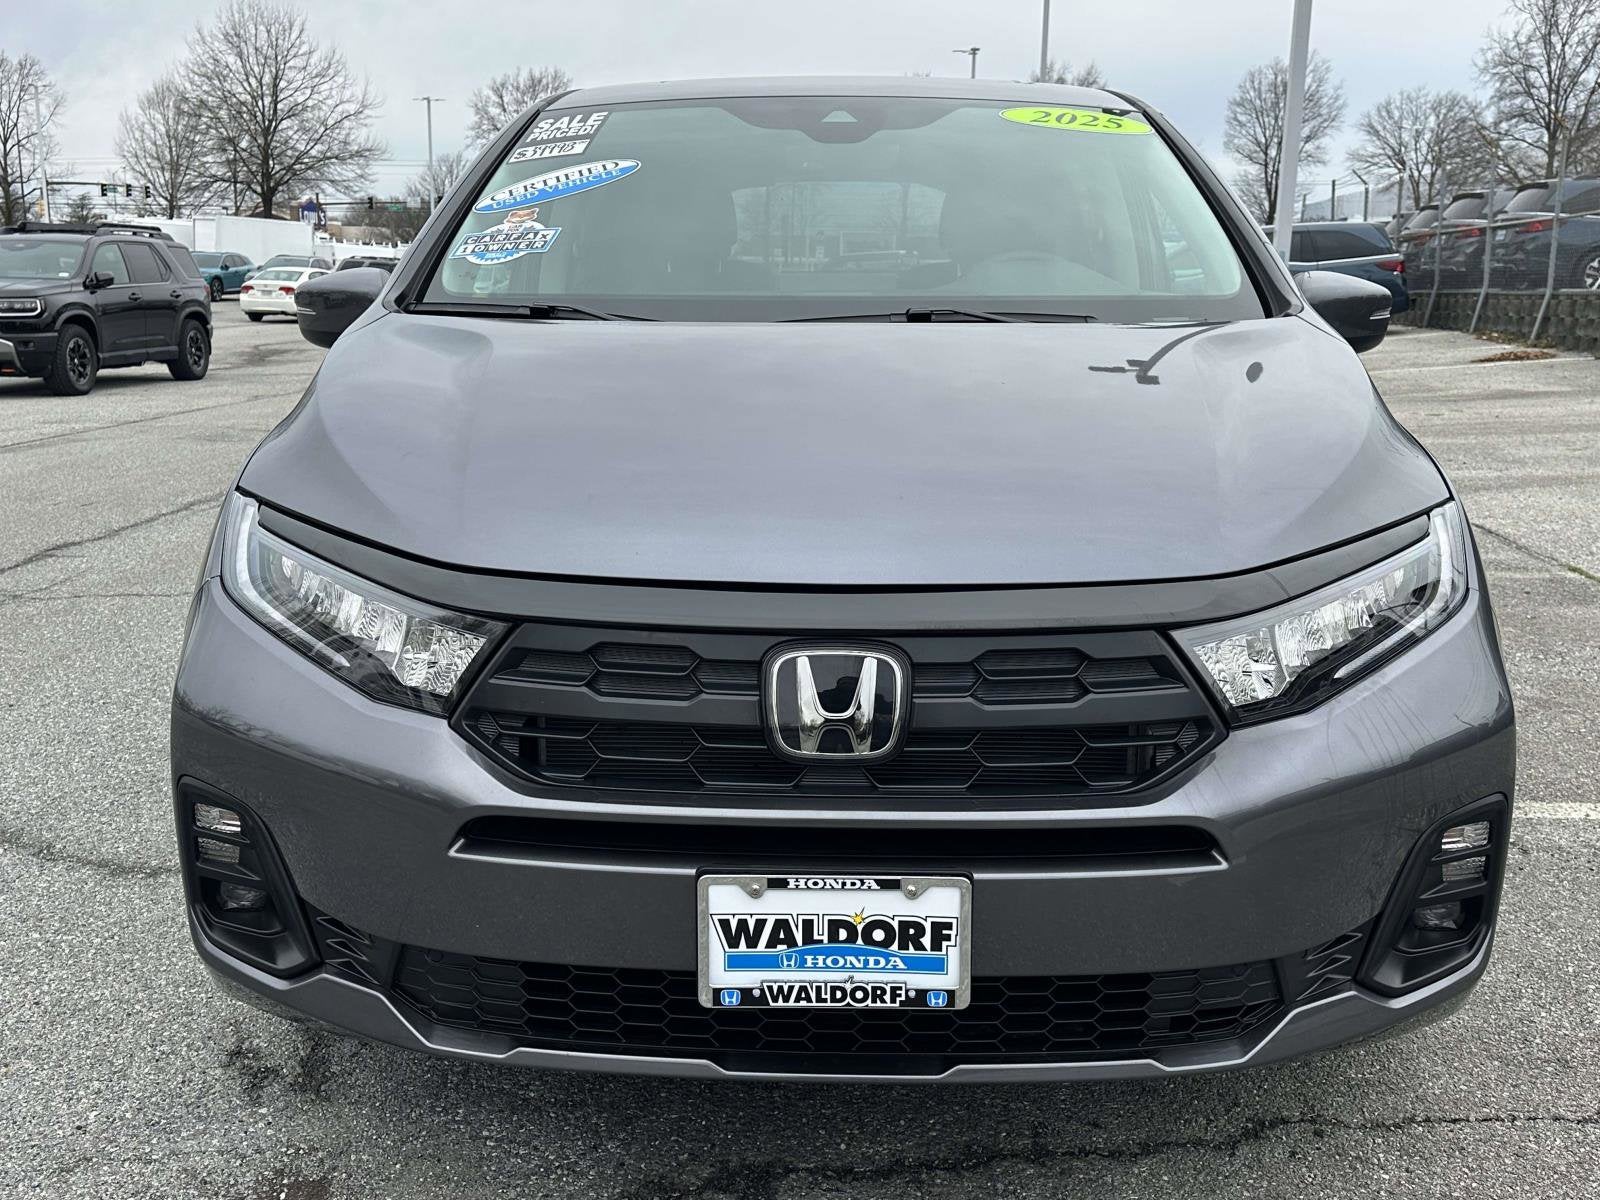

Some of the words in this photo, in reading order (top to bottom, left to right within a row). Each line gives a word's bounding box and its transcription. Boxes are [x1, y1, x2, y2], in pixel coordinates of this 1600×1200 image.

[533, 111, 609, 133] SALE
[1029, 110, 1123, 129] 2025
[525, 125, 599, 143] PRICED!
[490, 160, 620, 202] CERTIFIED
[492, 190, 540, 209] USED
[544, 169, 623, 193] VEHICLE
[466, 232, 550, 245] CARFAX
[786, 878, 881, 890] HONDA
[713, 915, 956, 953] WALDORF
[804, 955, 908, 969] HONDA
[764, 983, 907, 1005] WALDORF
